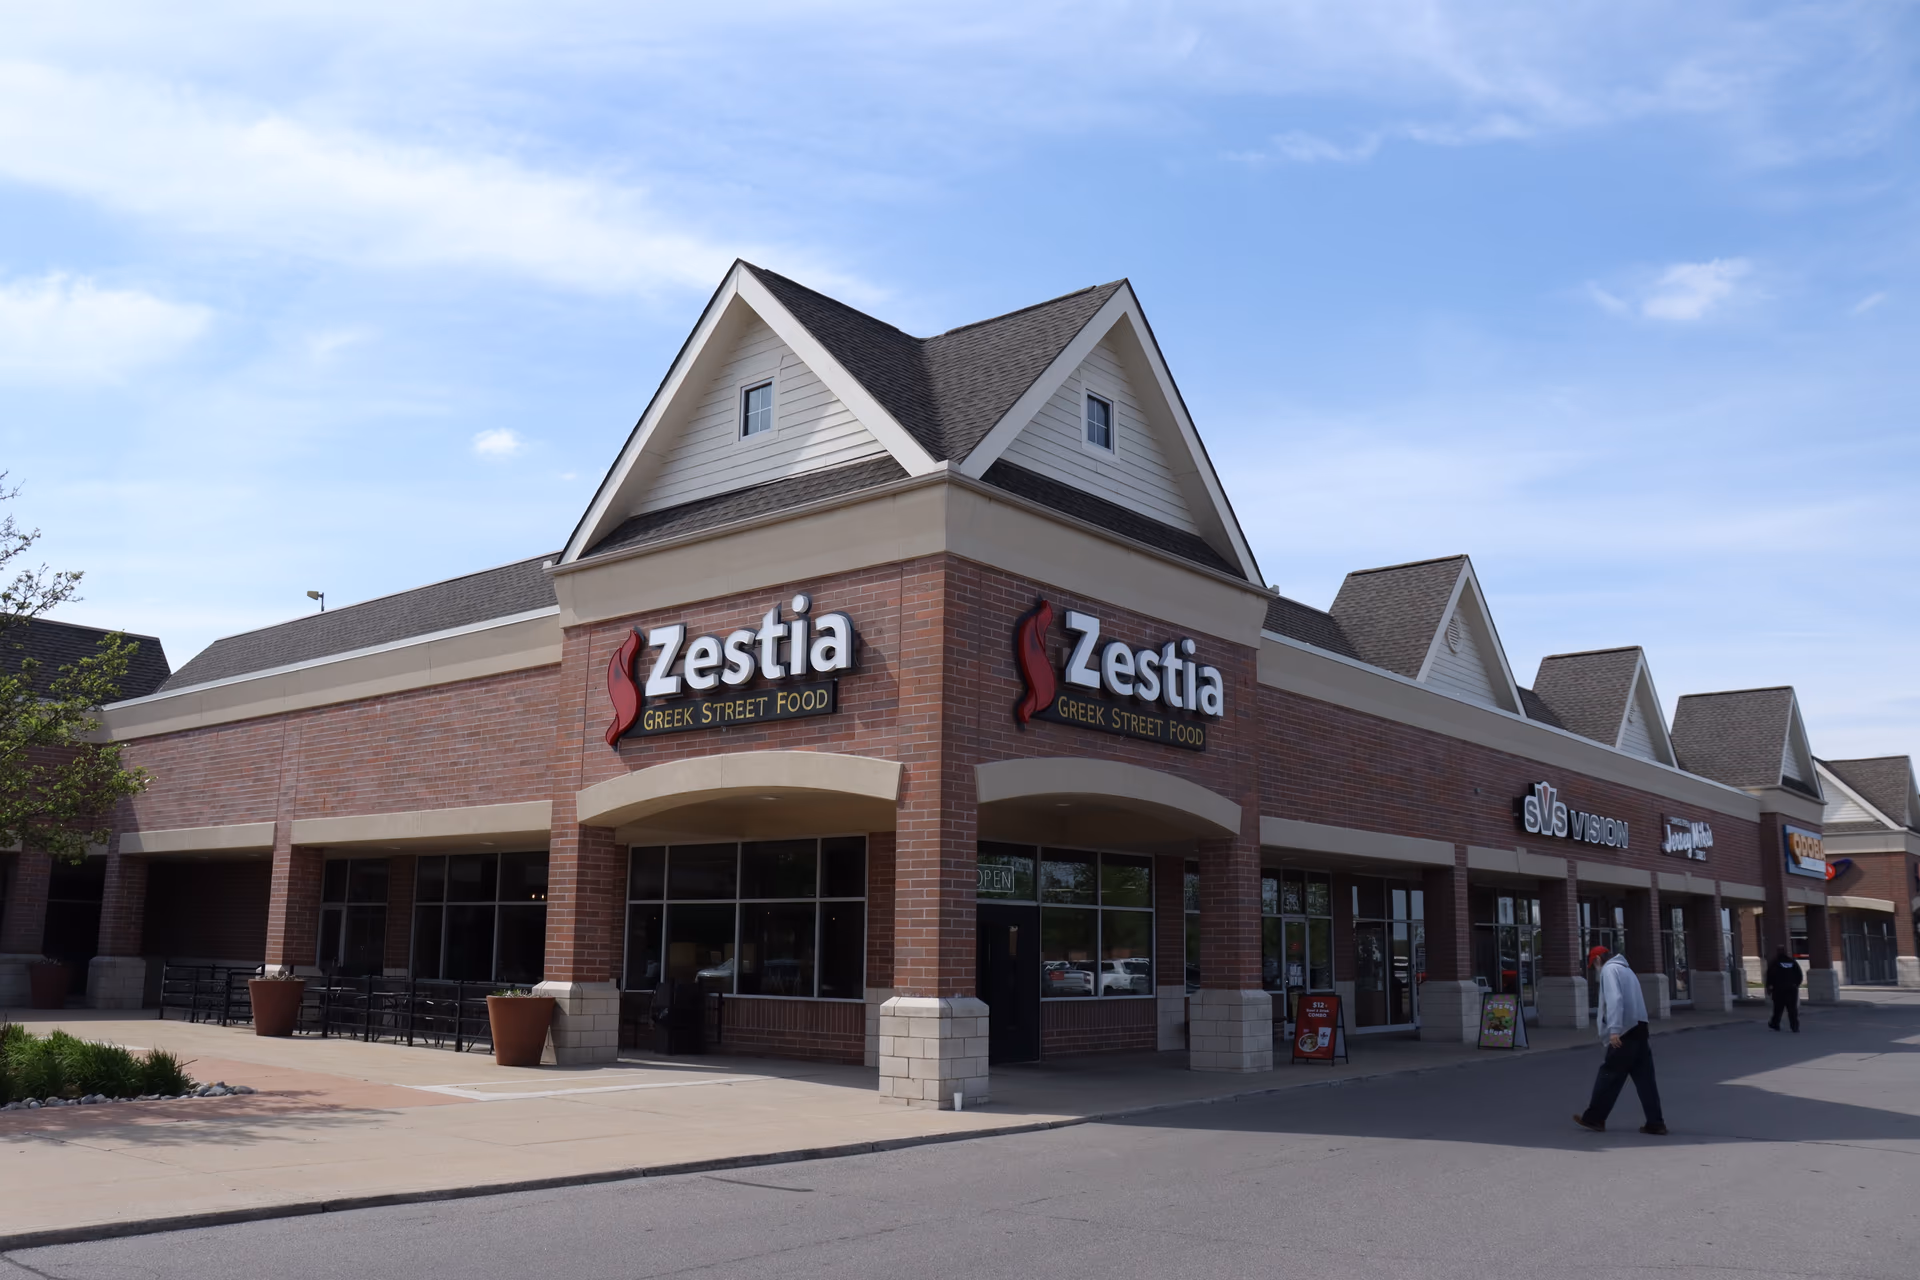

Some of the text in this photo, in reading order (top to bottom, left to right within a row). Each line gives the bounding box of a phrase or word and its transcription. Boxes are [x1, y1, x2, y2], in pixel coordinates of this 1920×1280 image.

[645, 594, 855, 697] Zestia
[1064, 610, 1224, 717] Zestia
[643, 689, 828, 731] GREEK STREET FOOD
[1057, 696, 1204, 746] GREEK STREET FOOD
[1570, 809, 1629, 849] VISION
